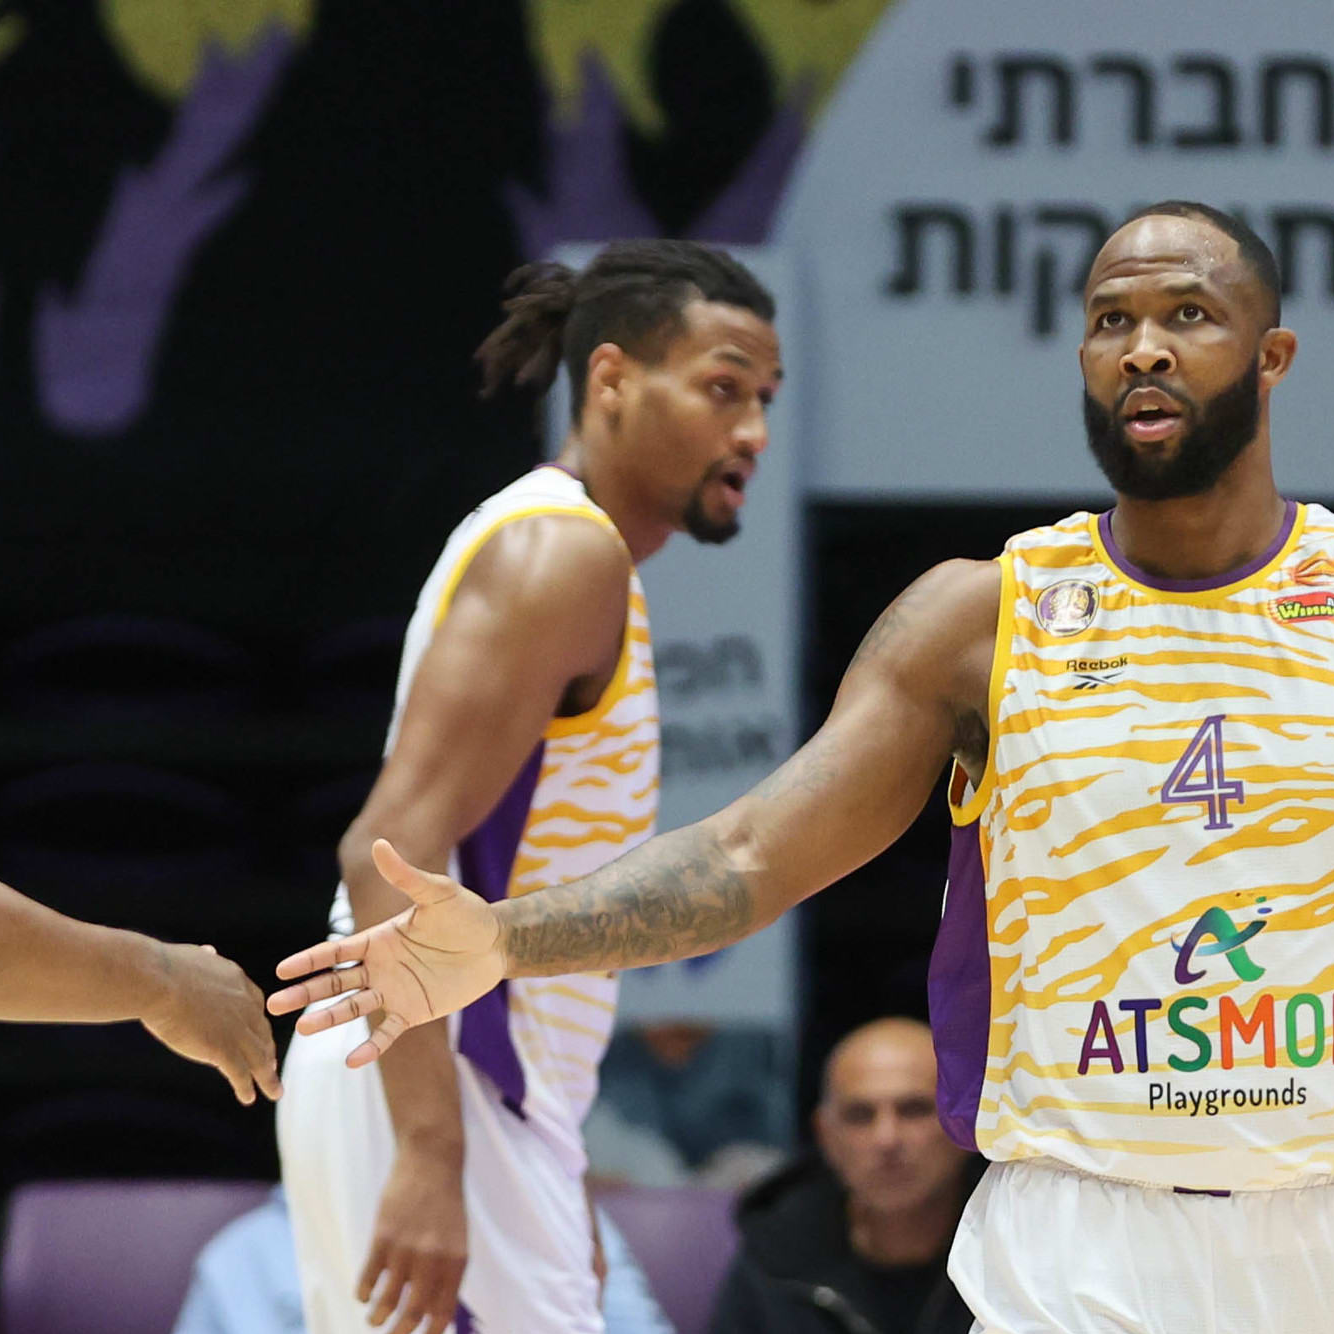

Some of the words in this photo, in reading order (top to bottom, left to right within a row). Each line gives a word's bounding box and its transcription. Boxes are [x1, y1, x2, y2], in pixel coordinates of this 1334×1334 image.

[1066, 657, 1128, 672] Reebok
[1160, 713, 1245, 831] 4
[1148, 1078, 1307, 1117] Playgrounds
